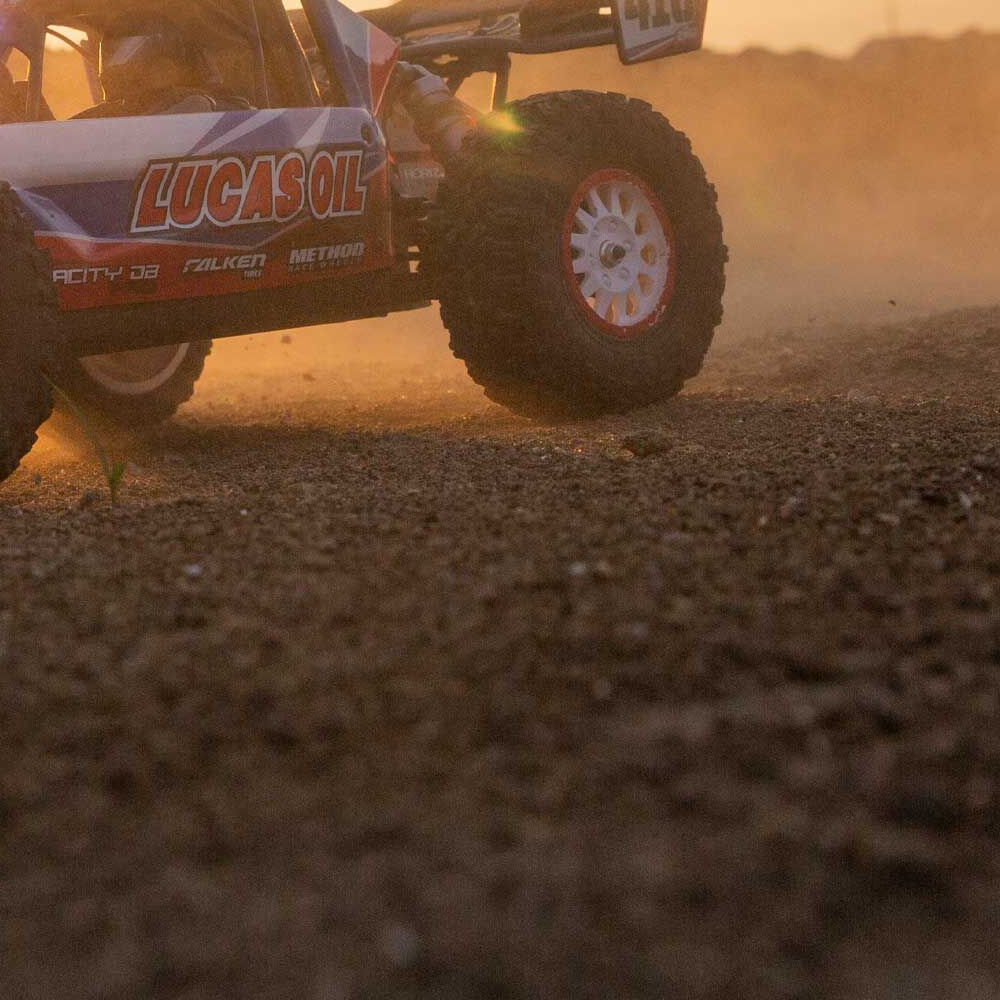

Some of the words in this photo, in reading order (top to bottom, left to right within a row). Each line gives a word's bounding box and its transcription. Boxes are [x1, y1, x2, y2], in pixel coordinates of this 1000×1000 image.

[130, 152, 305, 232] LUCAS
[309, 149, 367, 219] OIL
[183, 255, 266, 273] FALKEN
[290, 243, 364, 265] METHOD
